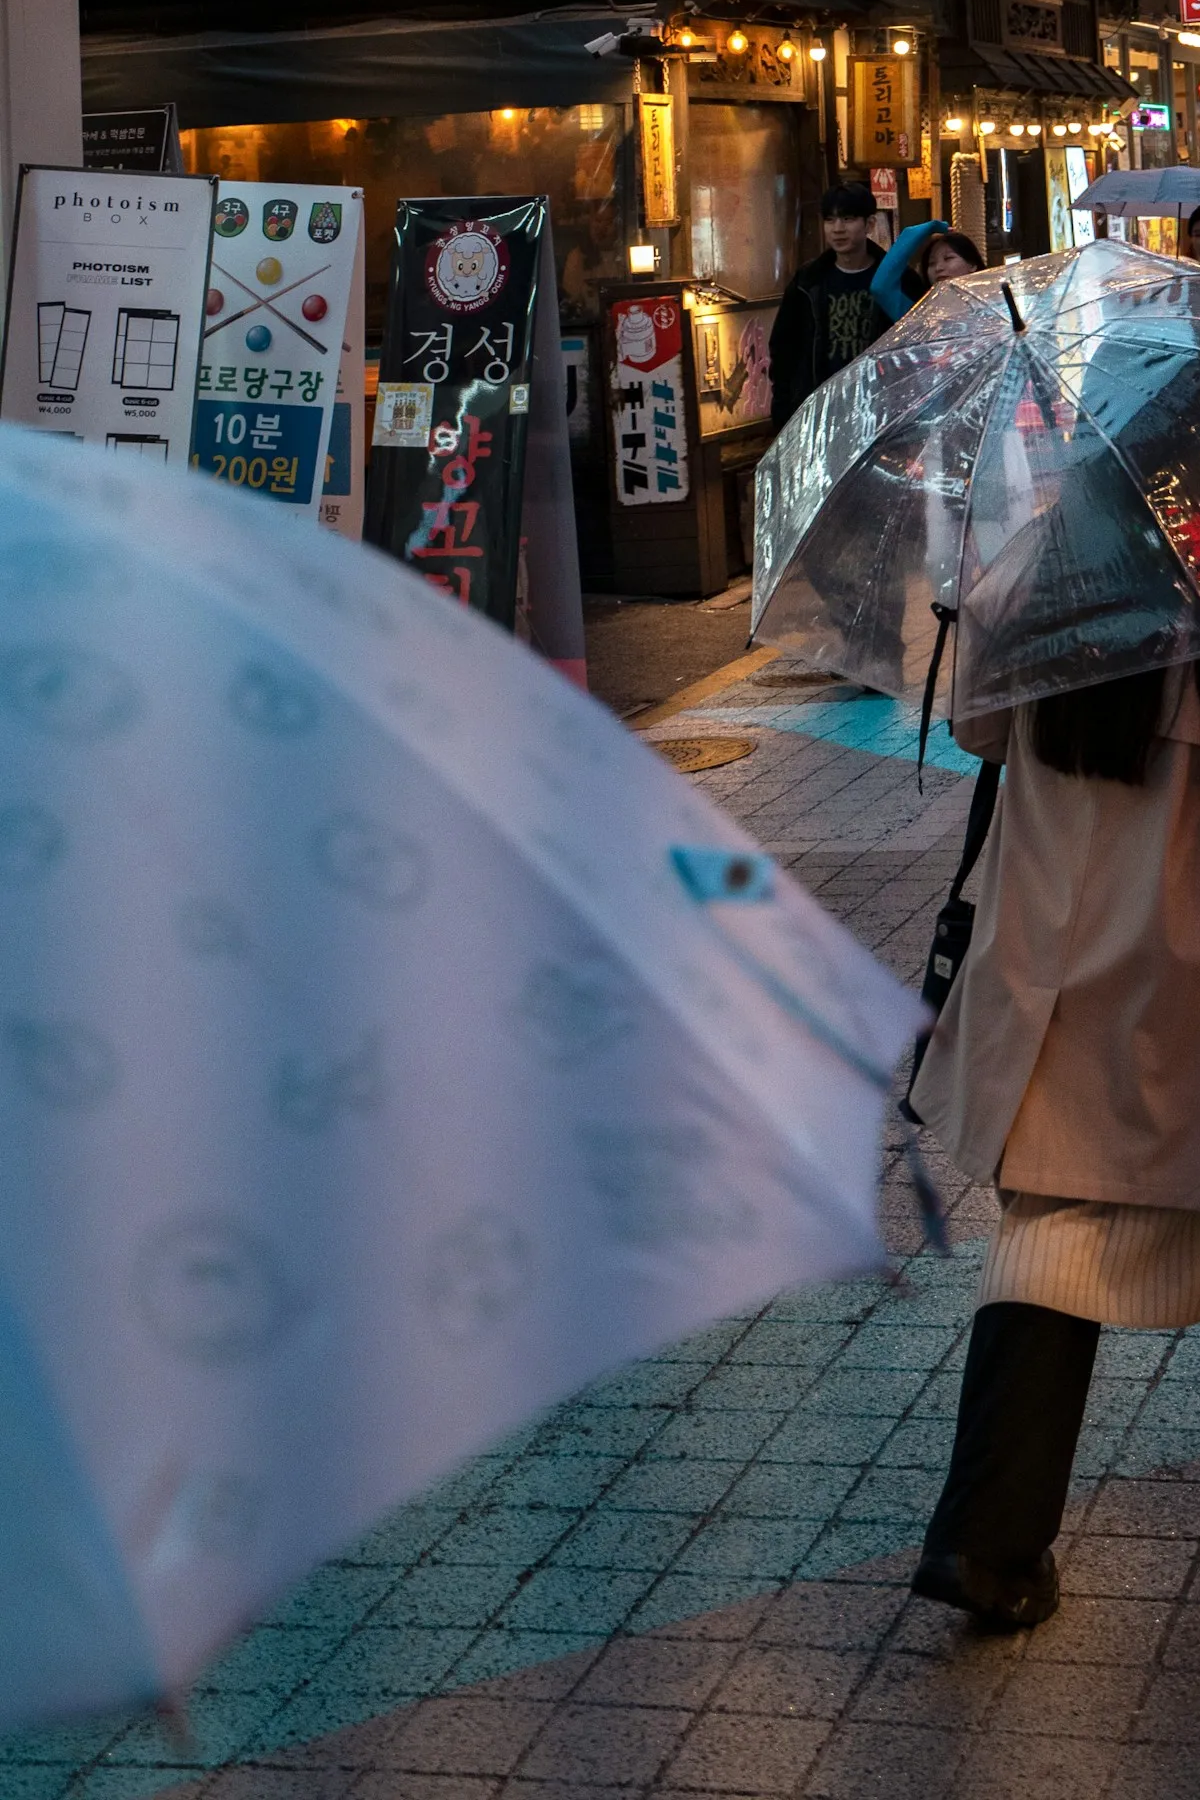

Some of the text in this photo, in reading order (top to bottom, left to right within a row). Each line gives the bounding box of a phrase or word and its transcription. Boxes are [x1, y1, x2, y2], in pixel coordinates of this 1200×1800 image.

[875, 66, 896, 146] 토리고야
[52, 192, 180, 214] photoism
[222, 202, 242, 214] 3구
[271, 204, 290, 217] 4구
[312, 228, 334, 241] 포켓
[72, 261, 150, 275] PHOTOISM
[120, 277, 153, 287] LIST
[427, 275, 462, 311] KYUNGSNG
[402, 319, 516, 384] 경성
[212, 413, 284, 451] 10분
